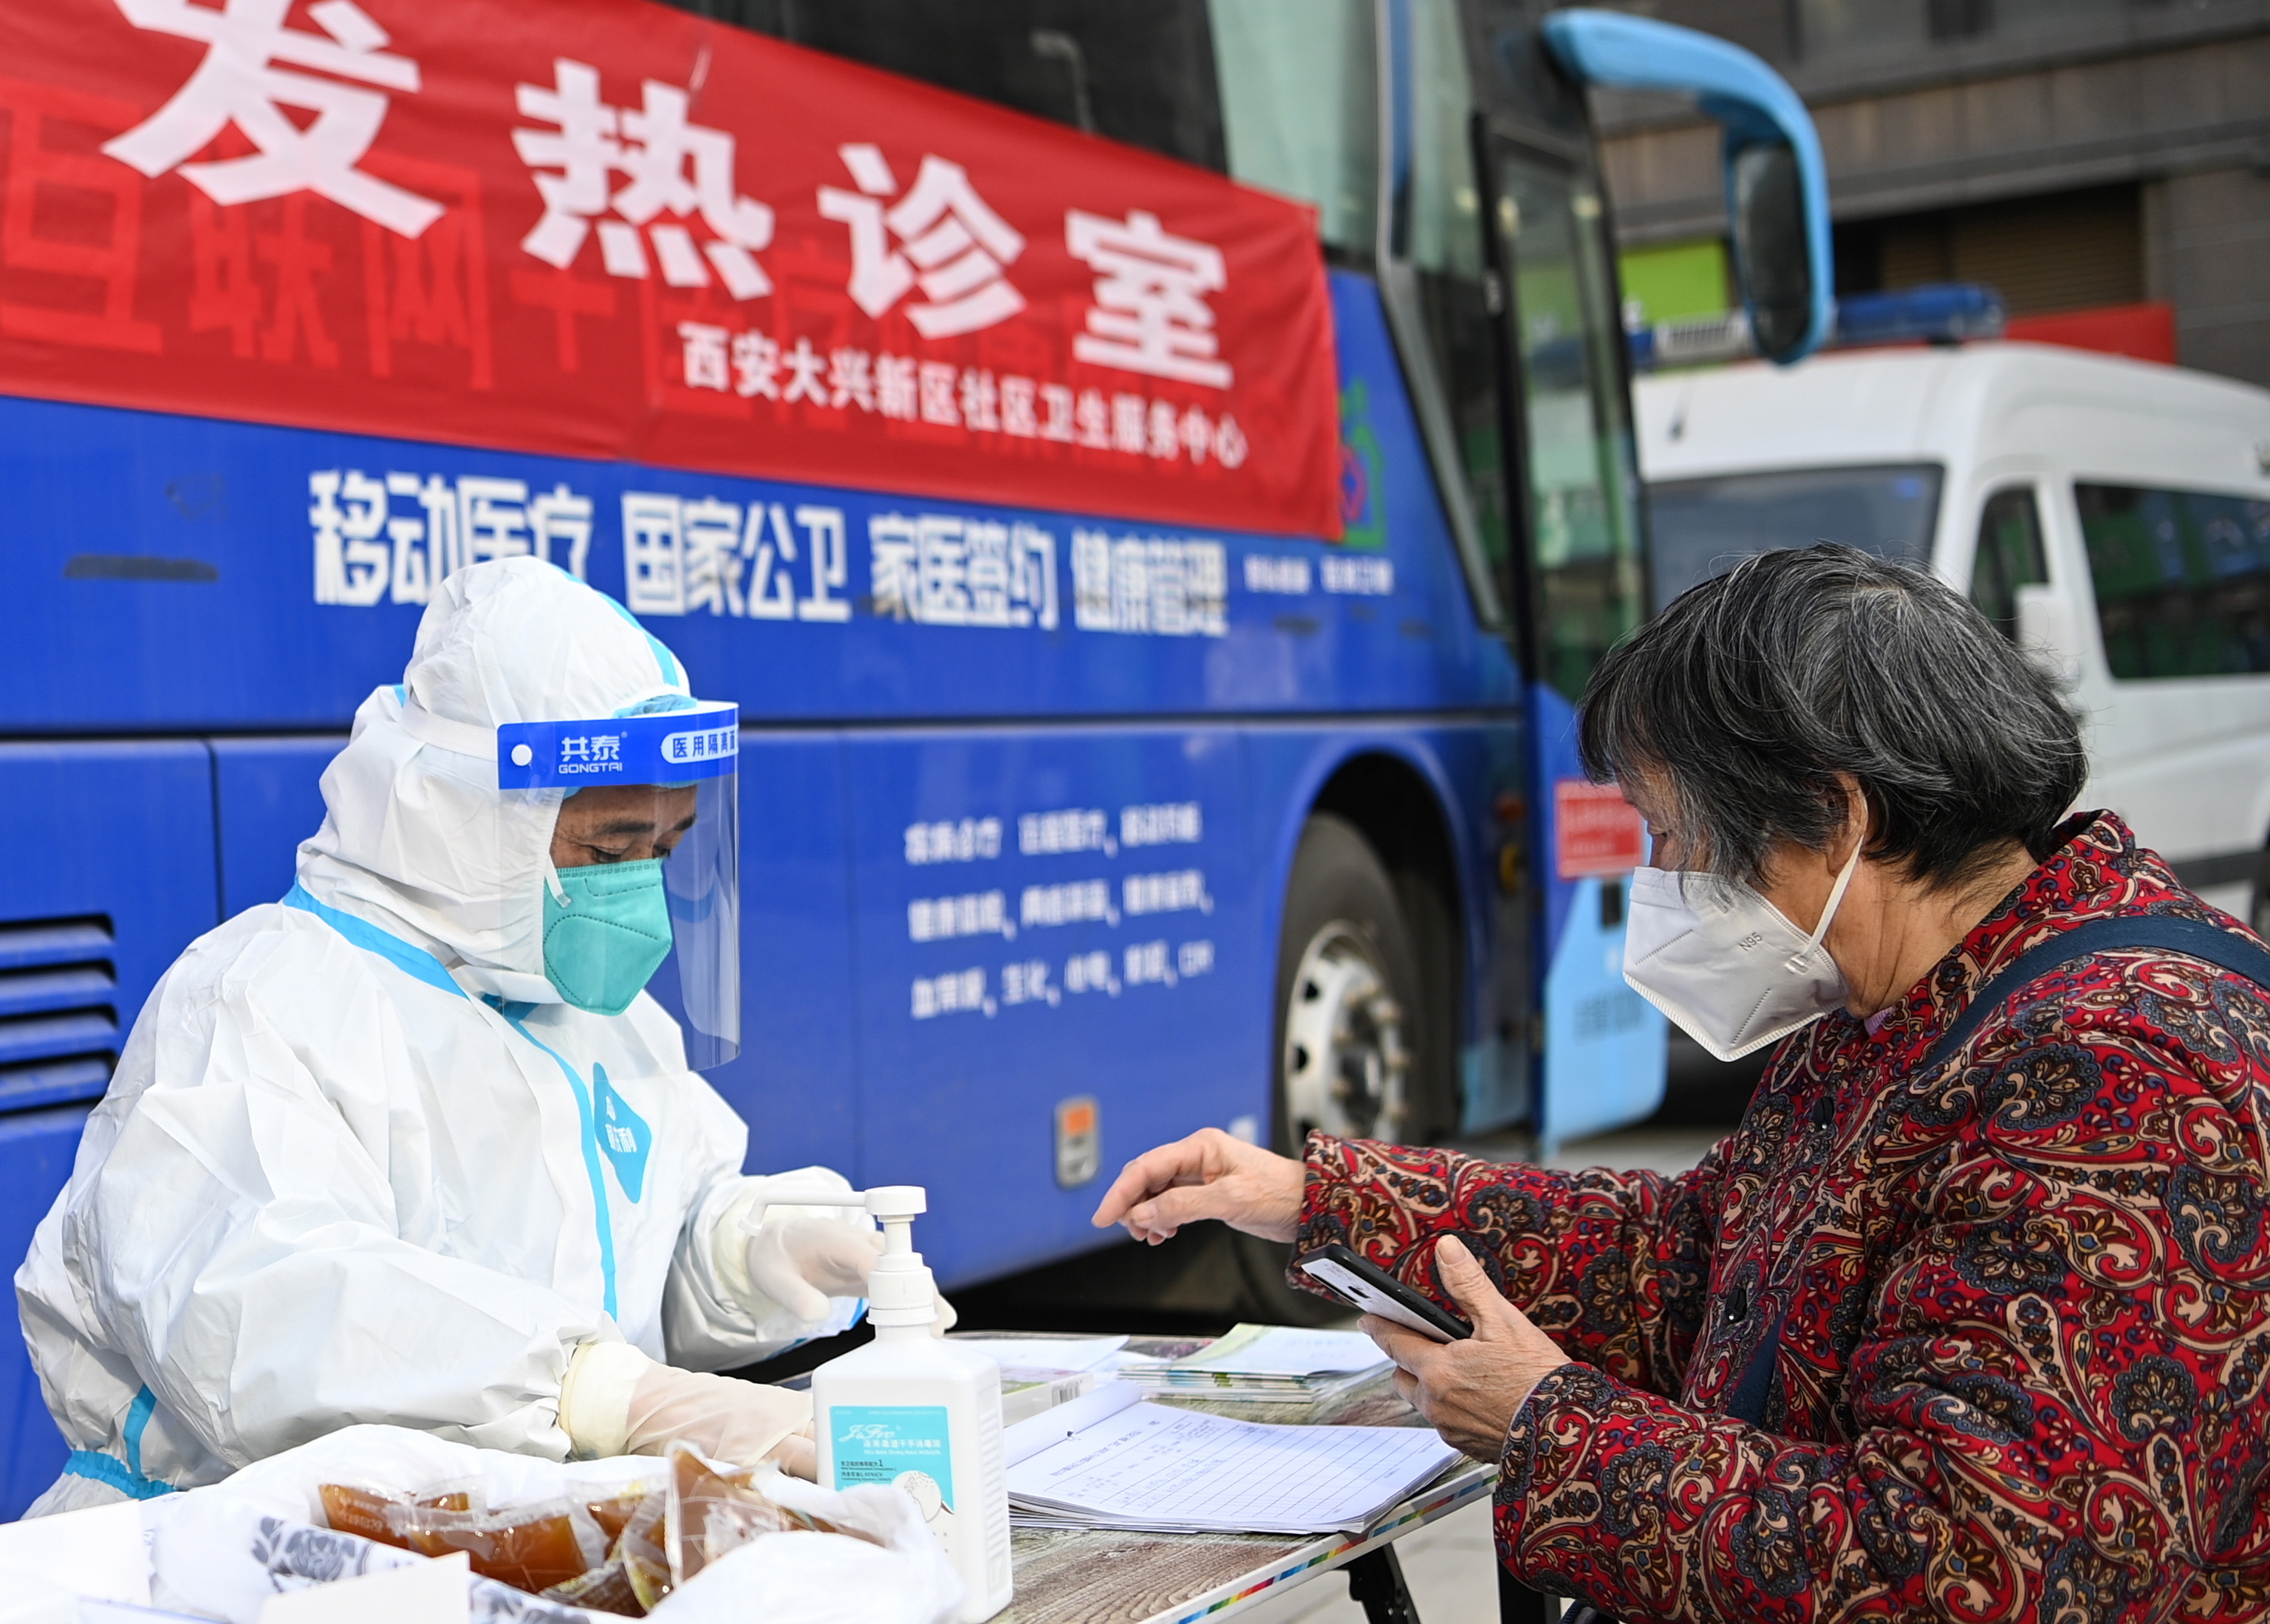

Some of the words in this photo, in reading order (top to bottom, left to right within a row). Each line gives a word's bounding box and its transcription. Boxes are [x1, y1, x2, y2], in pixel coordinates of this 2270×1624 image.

[100, 0, 1235, 389] 发热诊室
[677, 323, 1248, 470] 西安大兴新区社区卫生服务中心
[621, 489, 852, 623] 国家公卫
[1070, 527, 1230, 638] 健康管理
[558, 761, 623, 774] GONGTAI
[561, 736, 621, 762] 共泰
[1738, 931, 1763, 952] N95
